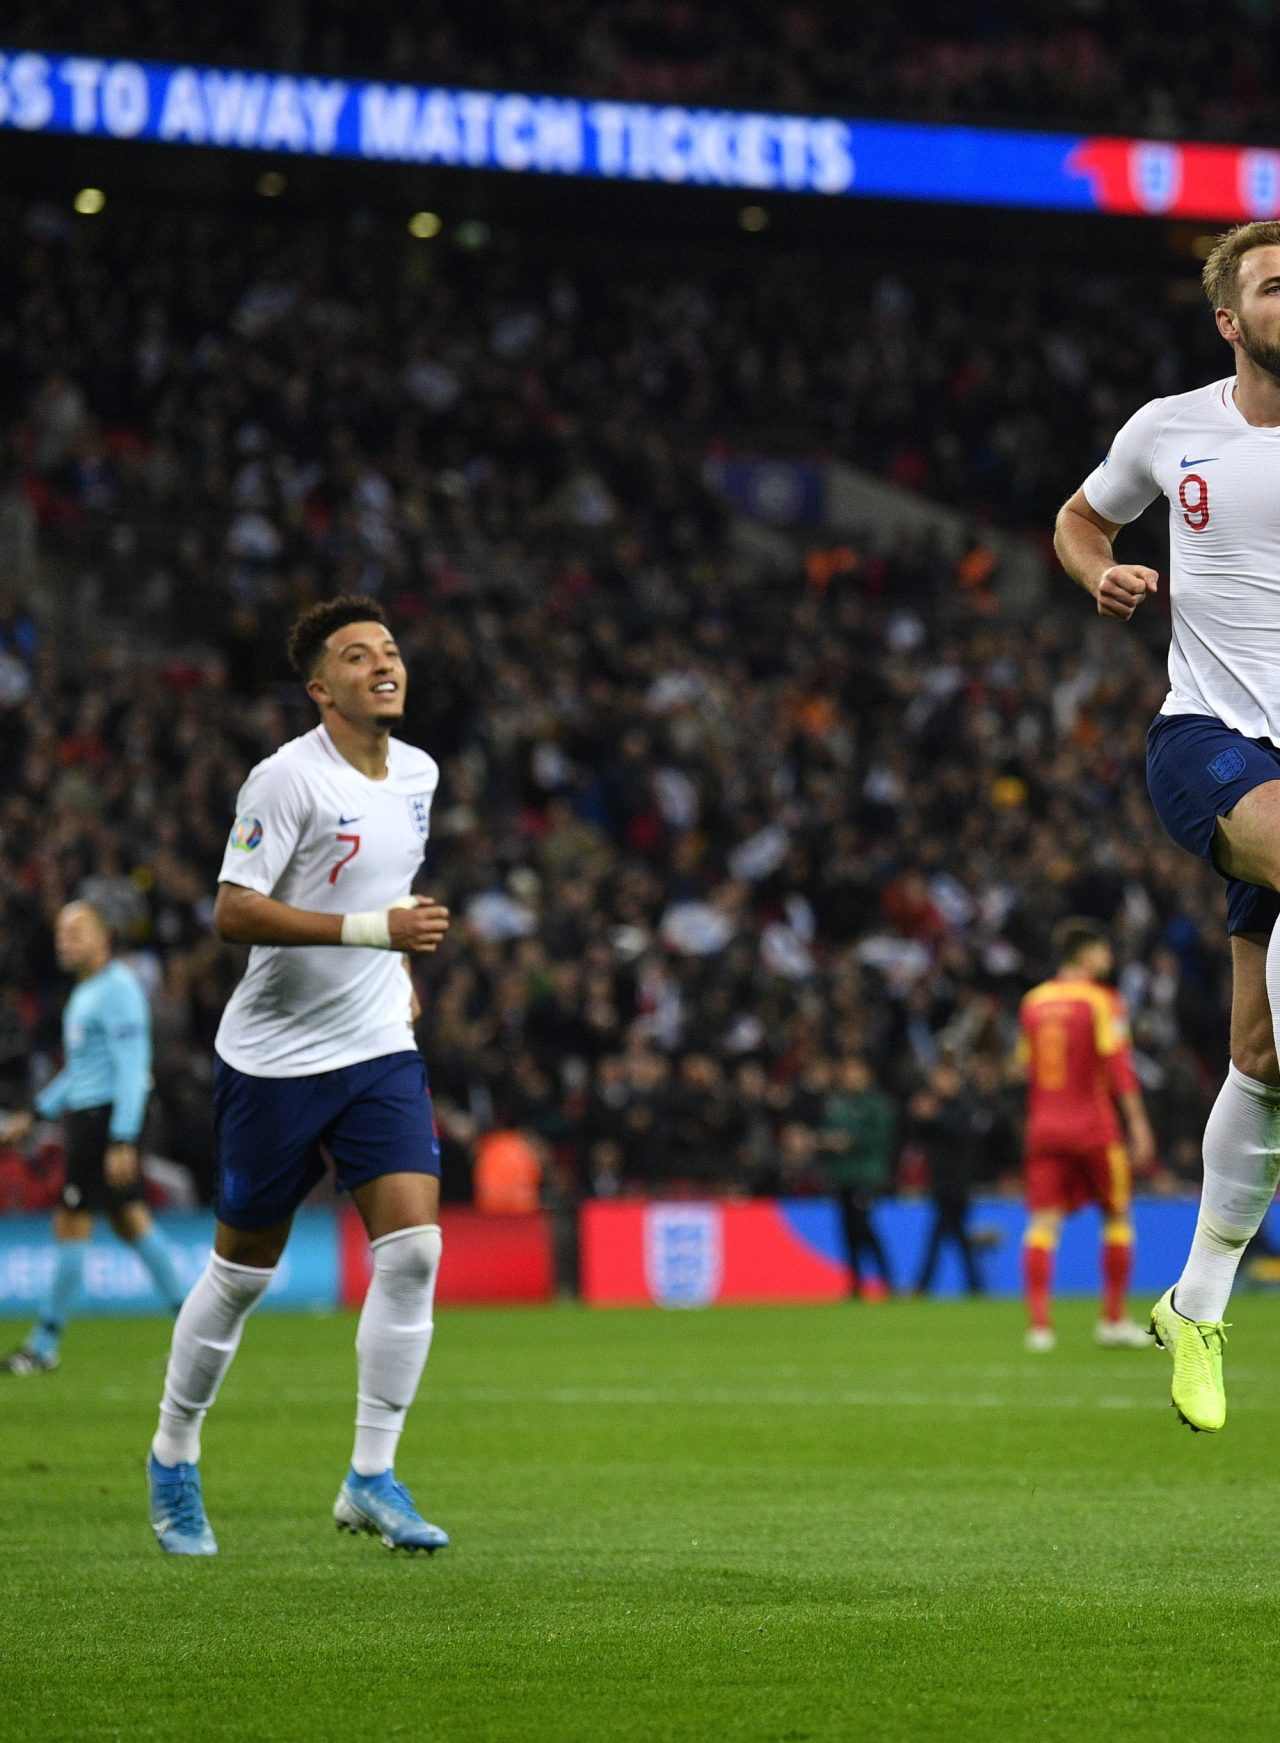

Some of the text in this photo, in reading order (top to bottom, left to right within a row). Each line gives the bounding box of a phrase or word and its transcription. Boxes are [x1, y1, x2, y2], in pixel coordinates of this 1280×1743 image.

[60, 57, 149, 139] TO
[158, 66, 348, 155] AWAY
[359, 83, 583, 174] MATCH
[588, 102, 853, 195] TICKETS
[1179, 474, 1209, 531] 9
[329, 834, 361, 885] 7
